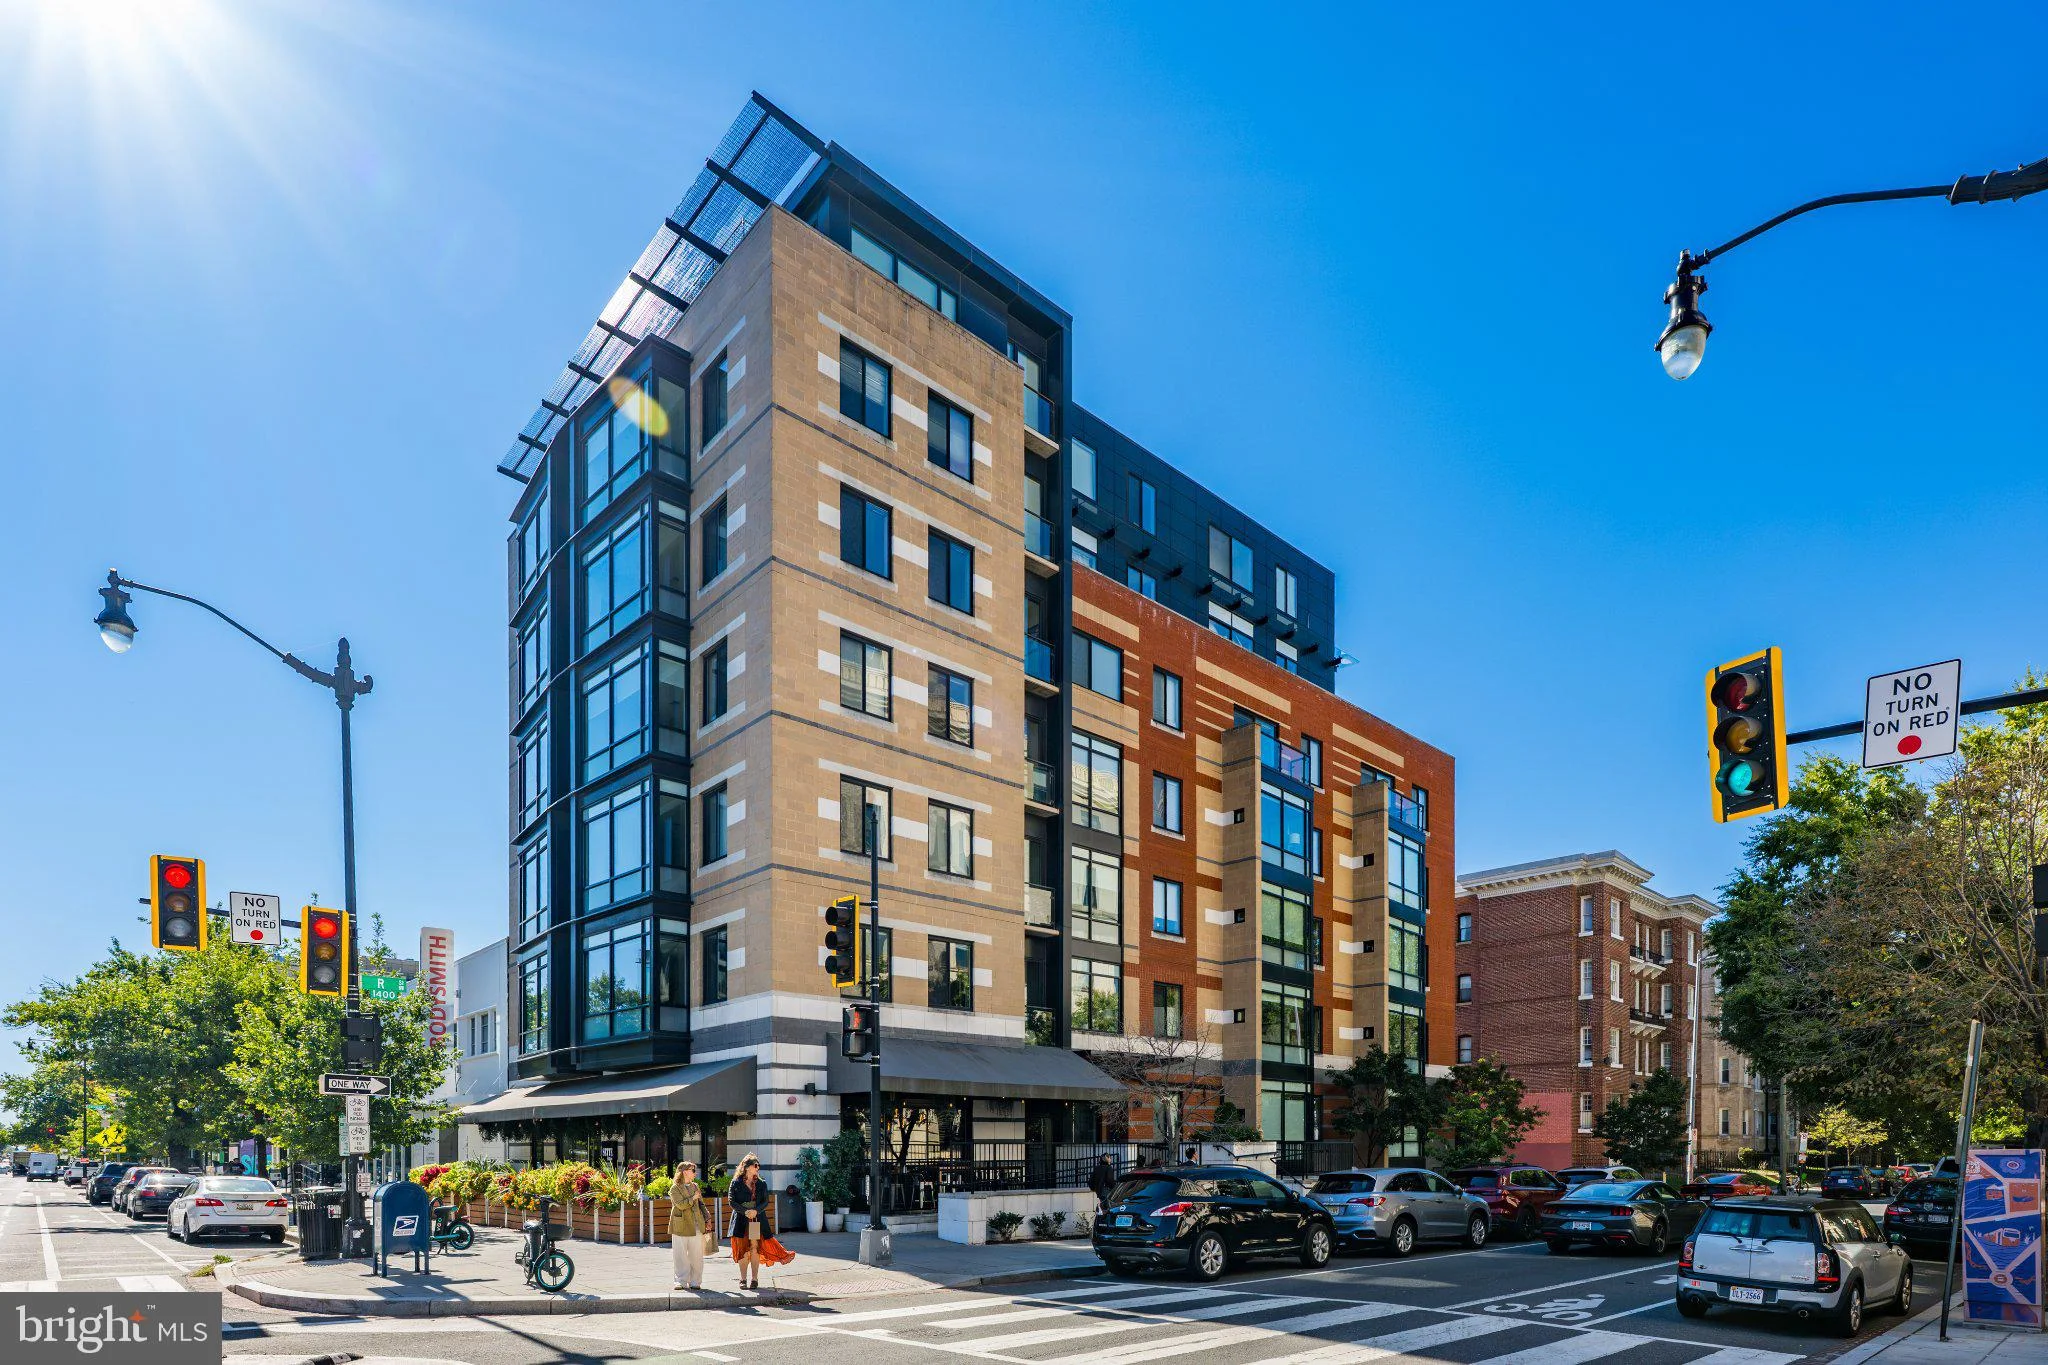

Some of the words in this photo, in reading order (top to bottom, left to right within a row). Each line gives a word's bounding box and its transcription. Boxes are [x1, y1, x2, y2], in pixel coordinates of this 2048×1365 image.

[1893, 673, 1932, 696] NO
[1886, 693, 1938, 715] TURN
[1873, 720, 1899, 736] ON
[1910, 711, 1949, 730] RED
[244, 897, 265, 908] NO
[242, 909, 270, 918] TURN
[235, 919, 251, 927] ON
[255, 921, 277, 929] RED
[377, 978, 385, 989] R
[373, 990, 396, 999] 1400
[331, 1080, 349, 1088] ONE
[353, 1081, 371, 1089] WAY
